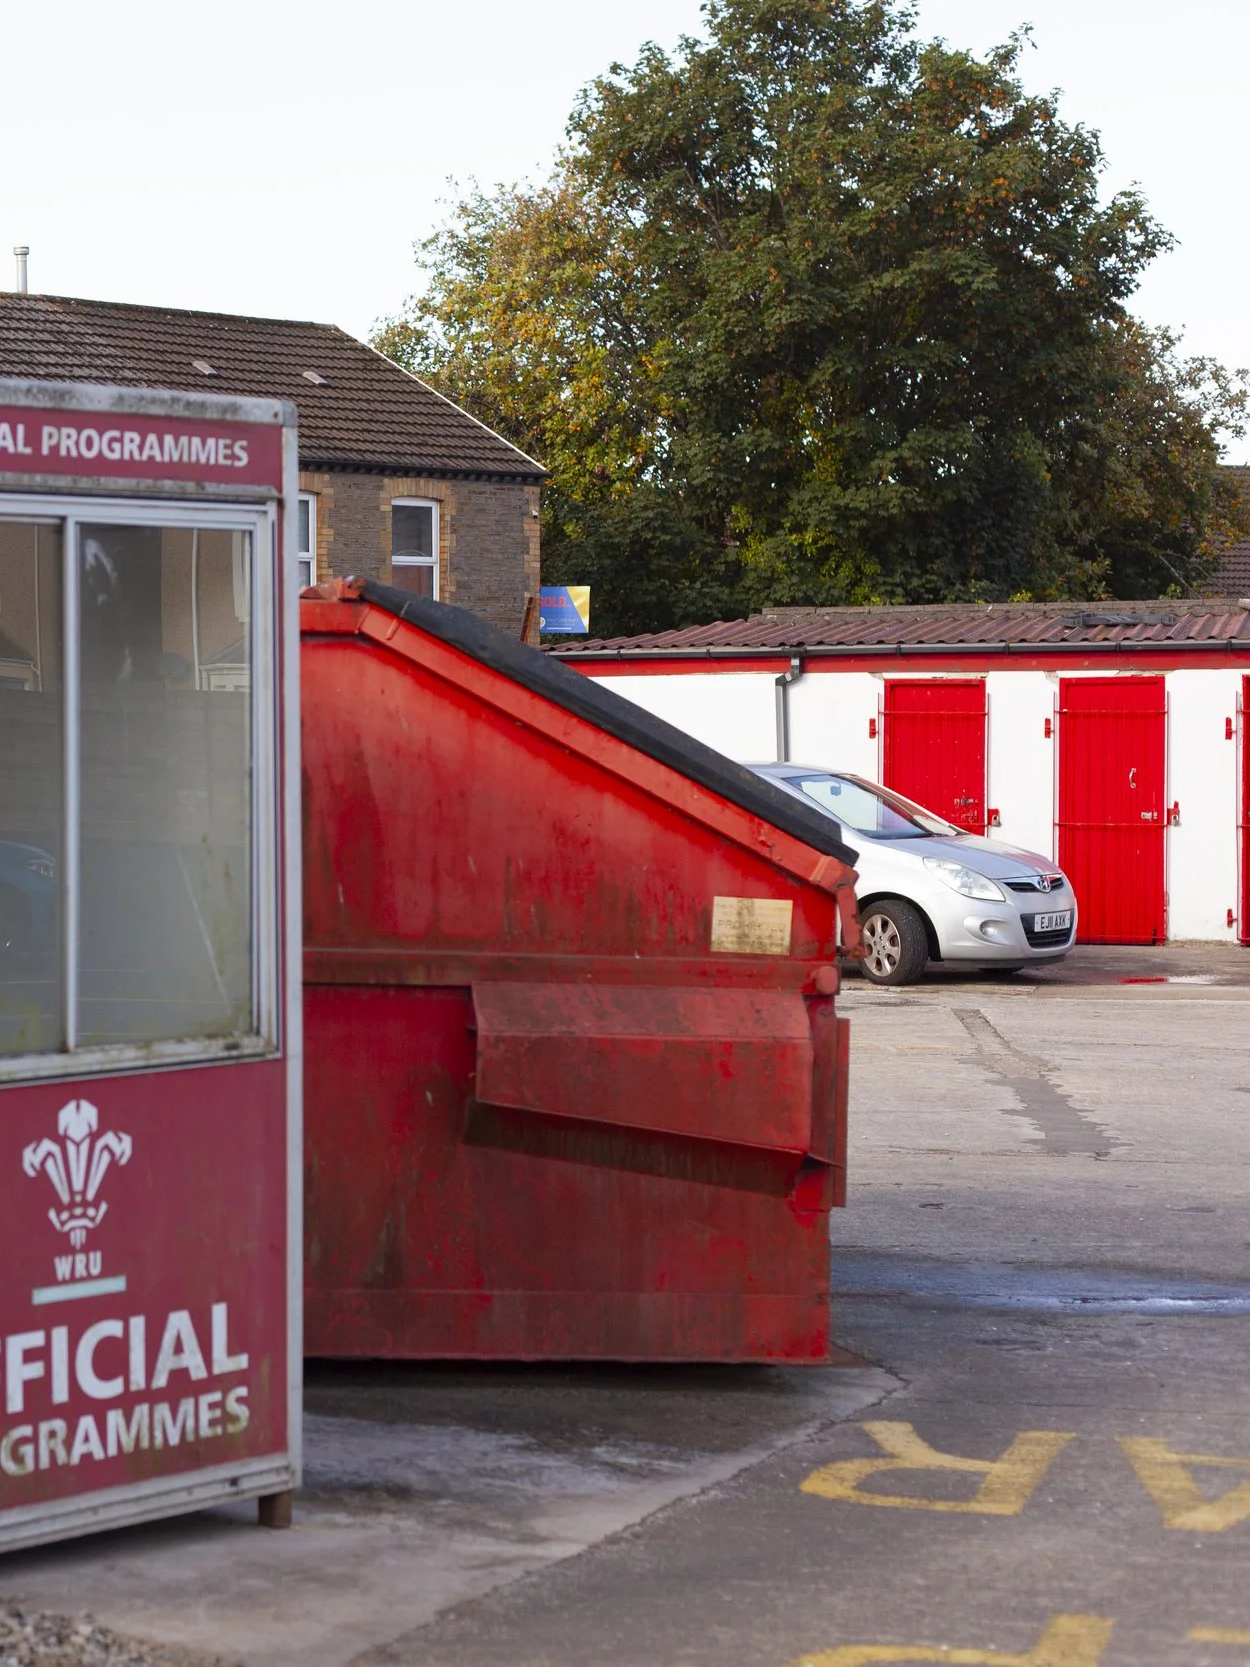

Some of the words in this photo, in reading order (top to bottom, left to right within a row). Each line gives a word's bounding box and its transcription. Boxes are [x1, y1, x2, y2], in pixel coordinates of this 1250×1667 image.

[41, 425, 249, 468] PROGRAMMES
[1041, 915, 1053, 929] EJ11
[1054, 913, 1067, 928] AXK
[54, 1251, 102, 1281] WRU
